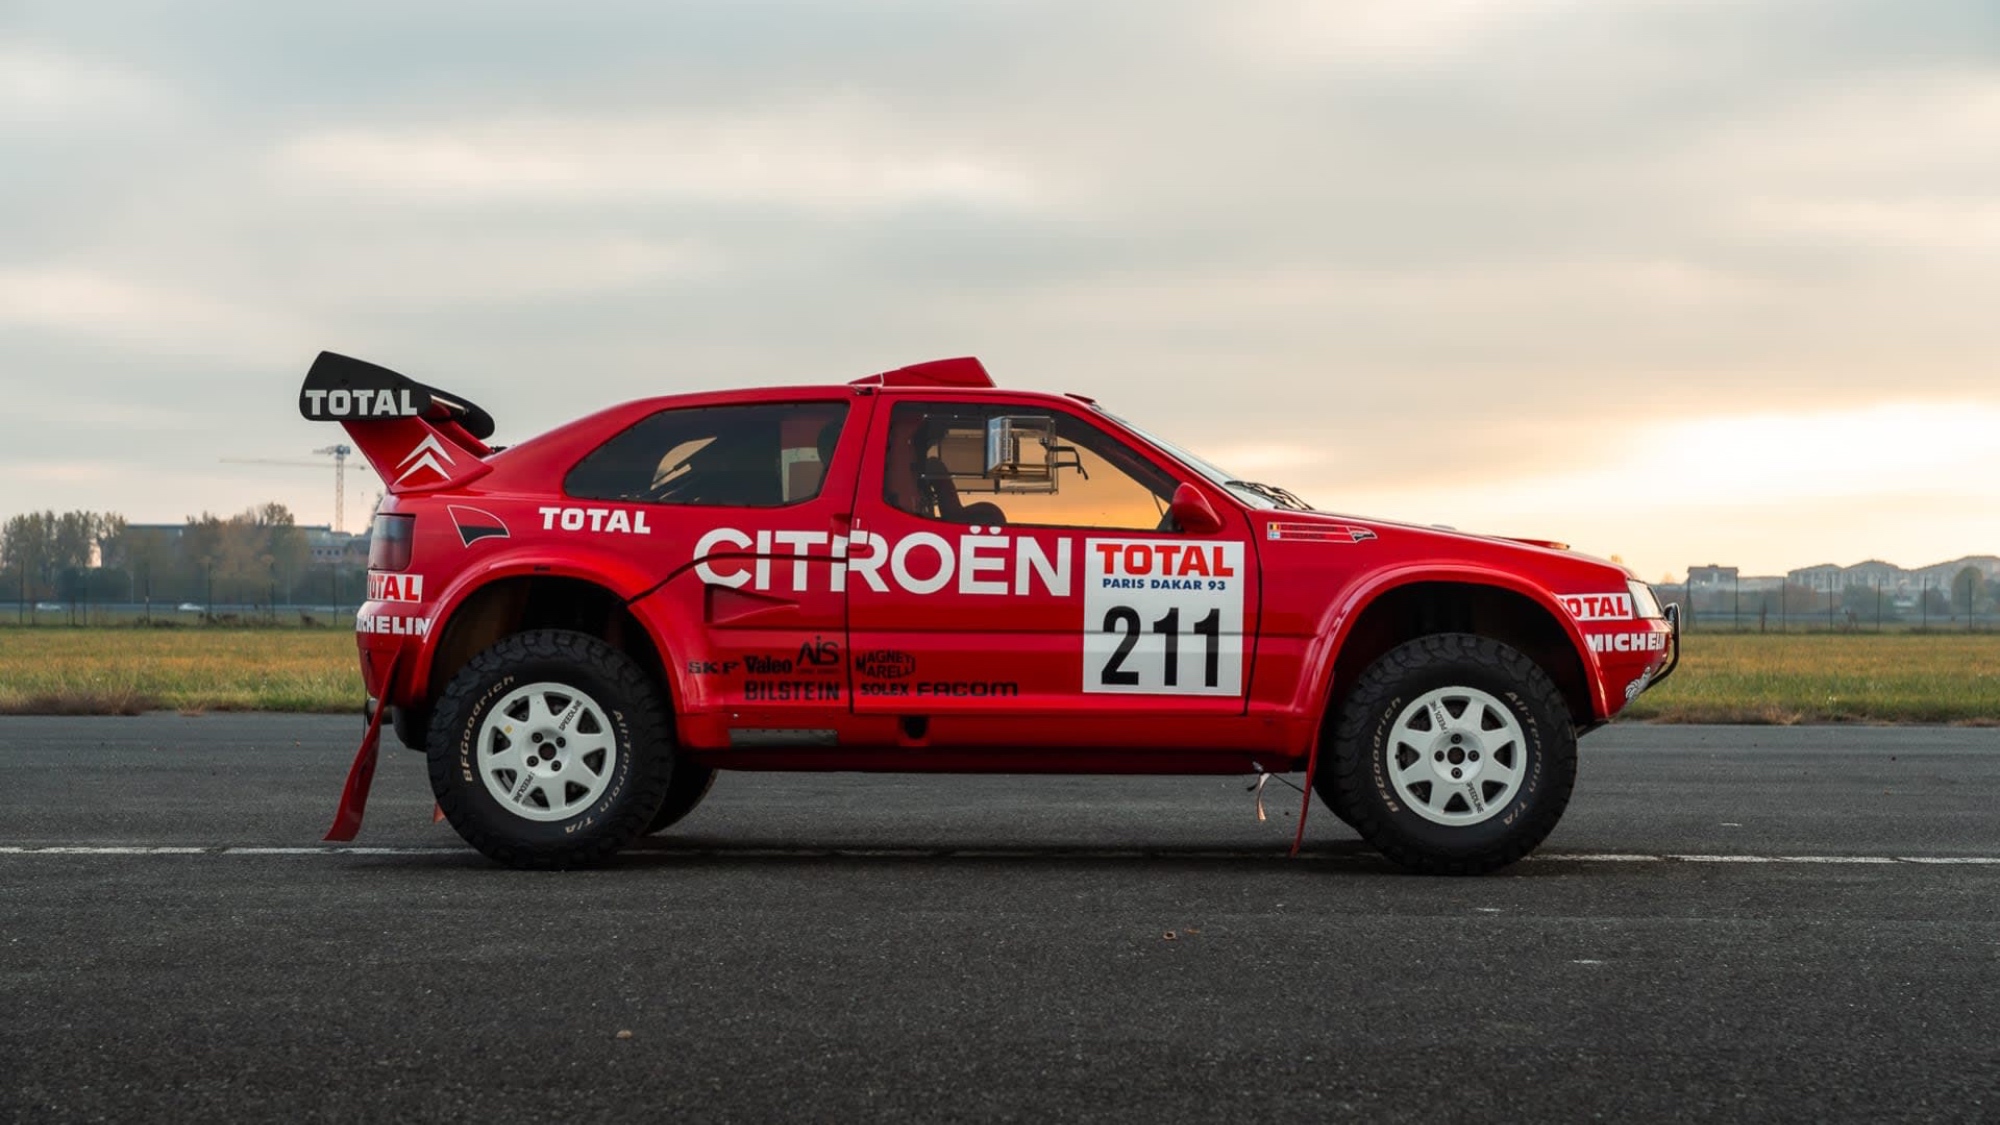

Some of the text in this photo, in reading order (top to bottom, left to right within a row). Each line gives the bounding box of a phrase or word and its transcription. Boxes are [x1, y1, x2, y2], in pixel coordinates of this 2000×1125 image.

[305, 388, 418, 416] TOTAL
[538, 506, 651, 535] TOTAL
[692, 525, 1072, 597] CITROËN
[1096, 544, 1234, 577] TOTAL
[1102, 578, 1226, 591] PARIS DAKAR 93
[1560, 596, 1629, 617] OTAL
[1101, 605, 1221, 688] 211
[743, 654, 792, 674] Valeo
[744, 679, 840, 701] BILSTEIN
[860, 682, 911, 696] SOLEX
[460, 676, 515, 781] BFGoodrich
